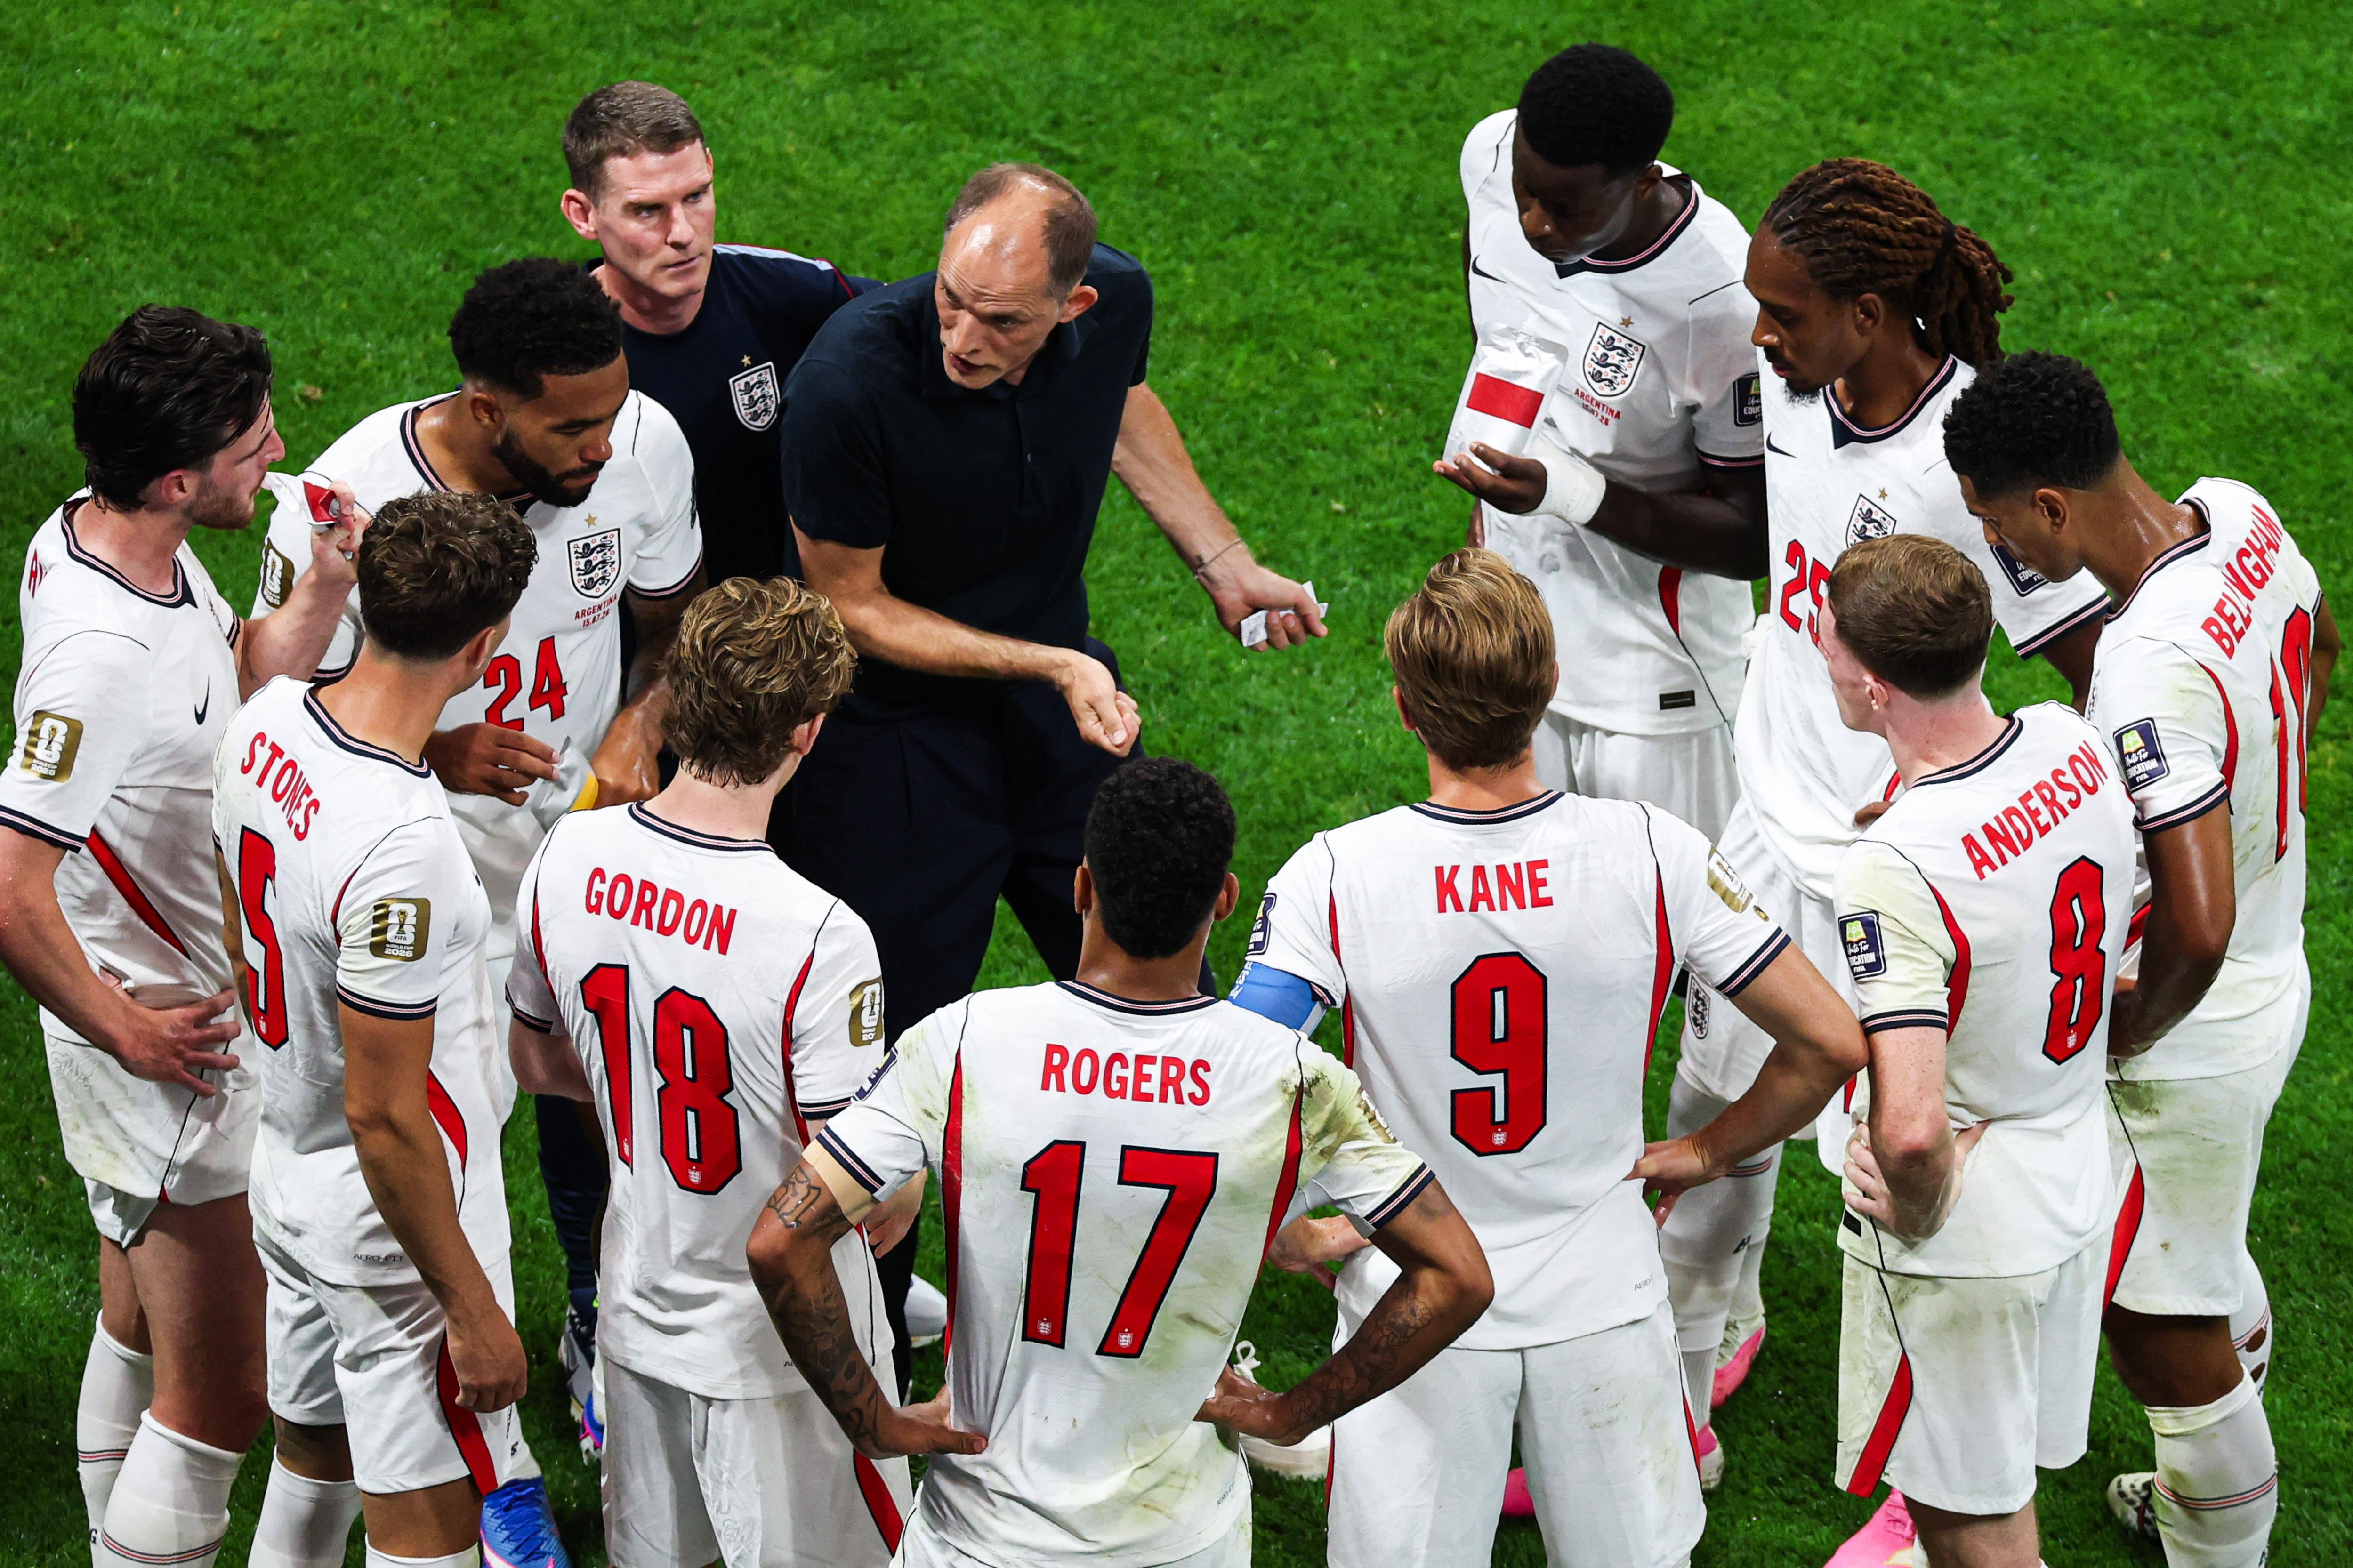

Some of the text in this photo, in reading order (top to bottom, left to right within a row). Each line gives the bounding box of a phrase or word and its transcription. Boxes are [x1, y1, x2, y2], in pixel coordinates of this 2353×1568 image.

[1575, 387, 1620, 420] ARGENTINA
[574, 593, 617, 620] ARGENTINA
[1780, 539, 1831, 648] 25
[2201, 504, 2283, 660] BELLNGHAM
[483, 635, 568, 731] 24
[2268, 603, 2312, 864] 10
[241, 732, 320, 842] STONES
[1961, 740, 2108, 881] ANDERSON
[238, 824, 288, 1051] 5
[585, 867, 737, 956] GORDON
[1435, 859, 1554, 914] KANE
[384, 948, 413, 957] 2026
[2042, 855, 2106, 1065] 8
[580, 963, 742, 1195] 18
[1041, 1043, 1211, 1107] ROGERS
[1451, 951, 1548, 1157] 9
[1020, 1140, 1219, 1358] 17
